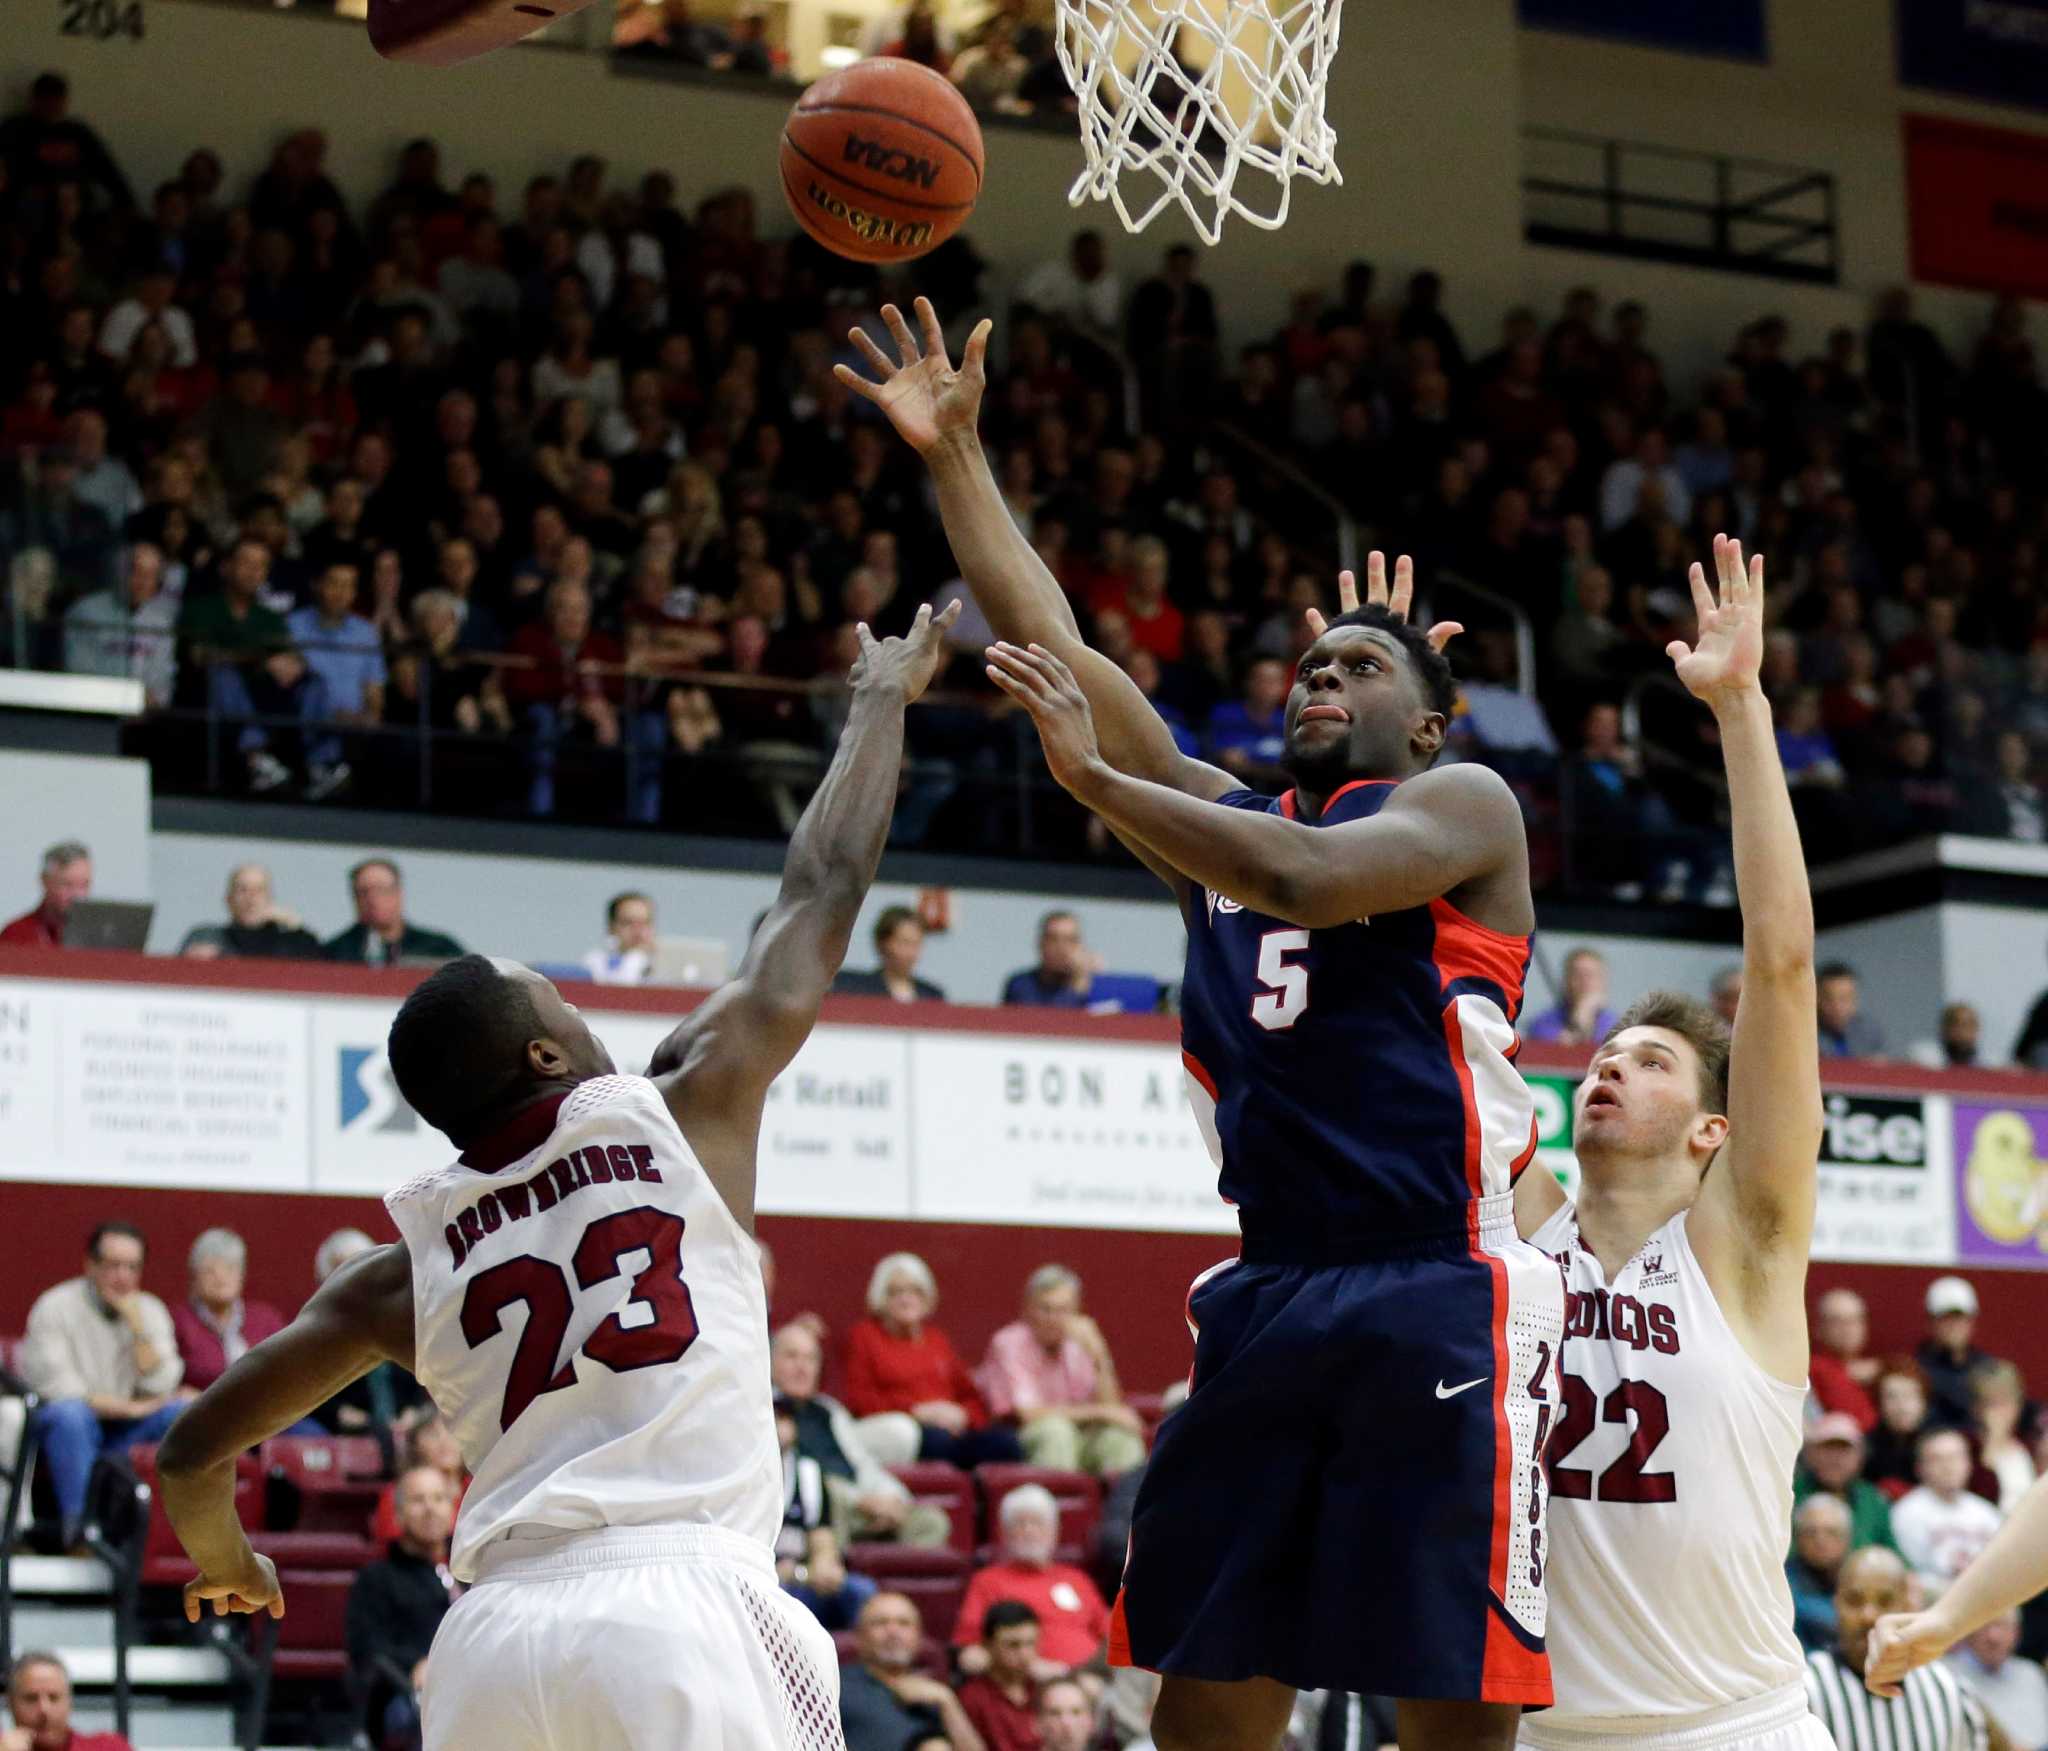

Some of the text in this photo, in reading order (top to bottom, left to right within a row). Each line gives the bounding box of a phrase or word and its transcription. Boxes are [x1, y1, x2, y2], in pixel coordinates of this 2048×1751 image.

[60, 0, 145, 41] 204
[842, 132, 941, 190] NCAA
[807, 179, 934, 247] Wilson
[1249, 928, 1311, 1031] 5
[1003, 1061, 1104, 1107] BON
[1824, 1095, 1924, 1163] ise
[459, 1205, 699, 1433] 23
[1548, 1374, 1677, 1503] 22
